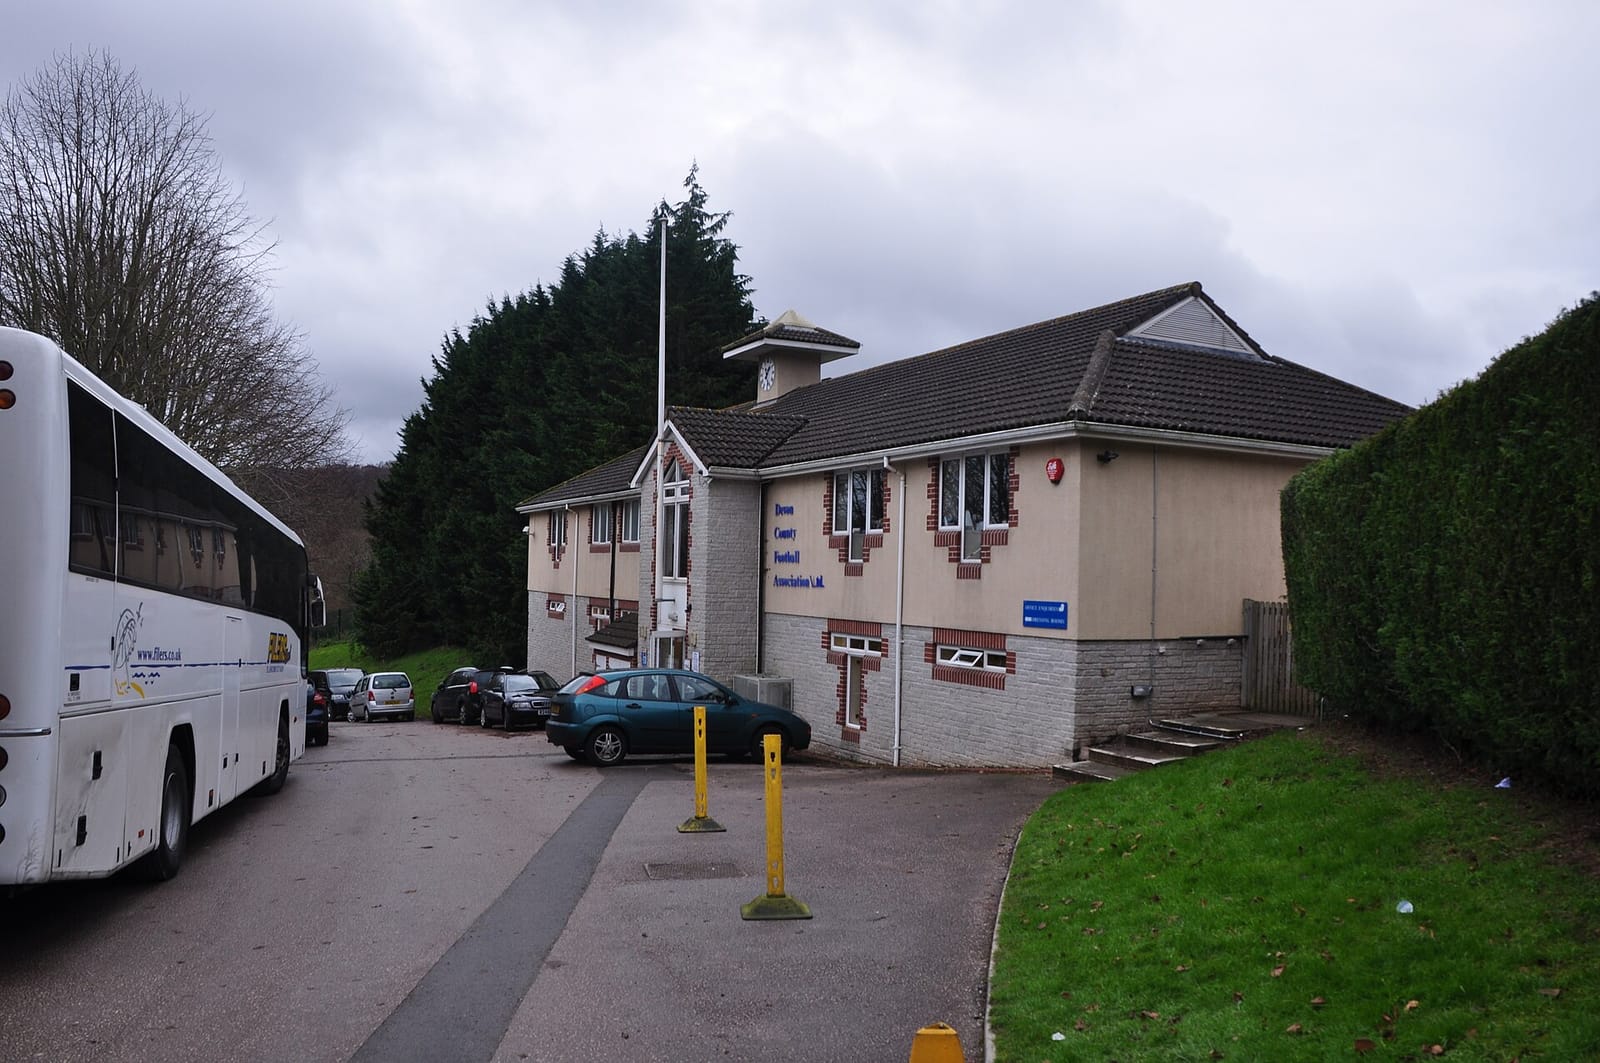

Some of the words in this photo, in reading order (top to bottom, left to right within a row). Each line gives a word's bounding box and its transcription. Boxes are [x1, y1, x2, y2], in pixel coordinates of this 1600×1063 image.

[775, 503, 794, 516] Devon
[774, 527, 796, 541] County
[774, 550, 800, 564] Football
[773, 574, 810, 588] Association
[137, 647, 182, 661] www.filers.co.uk
